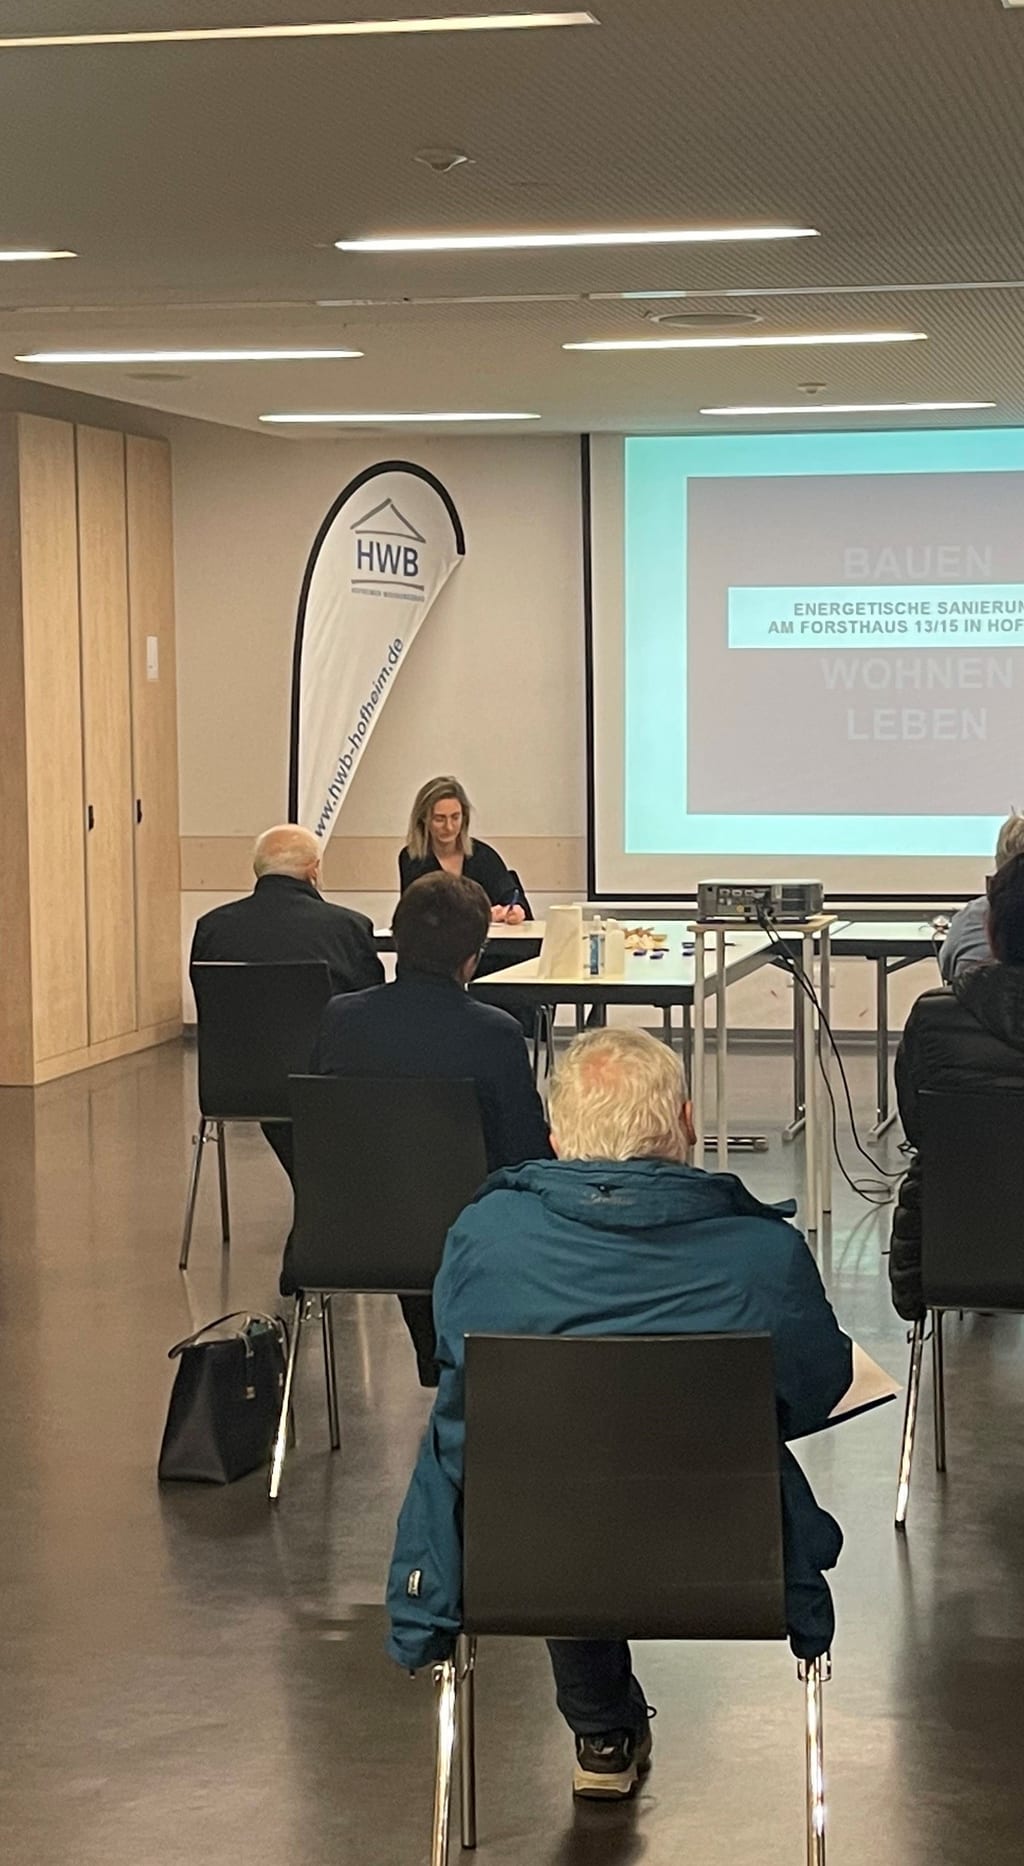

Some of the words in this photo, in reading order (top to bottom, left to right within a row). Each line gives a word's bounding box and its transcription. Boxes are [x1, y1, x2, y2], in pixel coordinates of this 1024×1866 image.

[357, 538, 419, 577] HWB
[844, 545, 993, 578] BAUEN
[793, 601, 931, 616] ENERGETISCHE
[768, 621, 794, 634] AM
[800, 619, 908, 634] FORSTHAUS
[914, 619, 959, 633] 13/15
[964, 618, 981, 632] IN
[820, 655, 1014, 689] WOHNEN
[314, 637, 404, 838] ww.hwb-hofheim.de
[846, 708, 988, 740] LEBEN
